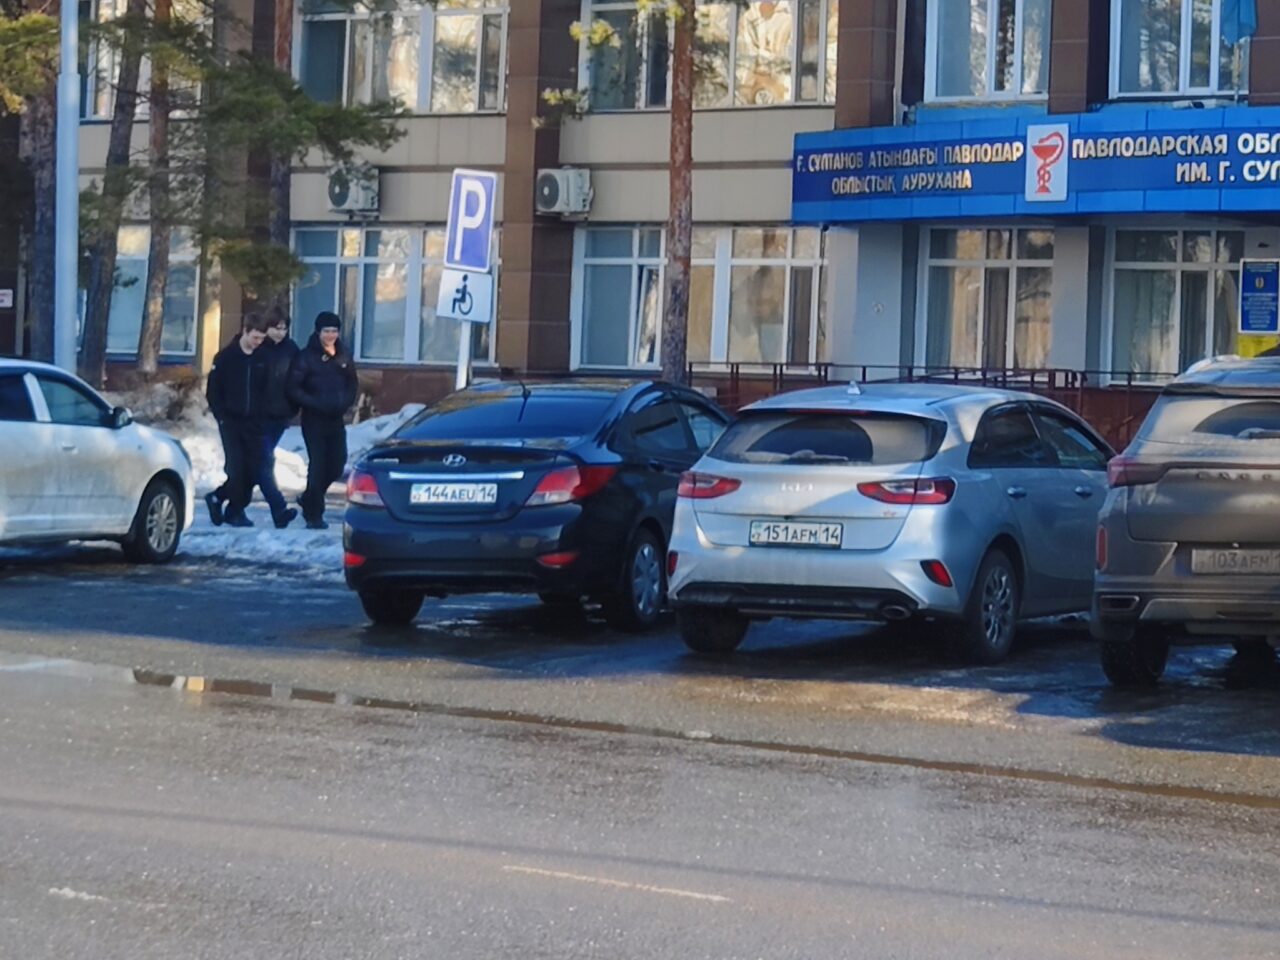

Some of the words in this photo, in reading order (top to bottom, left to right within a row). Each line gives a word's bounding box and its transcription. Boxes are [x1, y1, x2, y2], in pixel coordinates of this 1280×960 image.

[944, 141, 1024, 163] ПАВЛОДАР
[1072, 134, 1228, 159] ПАВЛОДАРСКАЯ
[902, 169, 972, 191] АУРУХАНА
[1176, 161, 1212, 182] ИМ.
[1219, 161, 1236, 182] Г.
[454, 178, 487, 261] P
